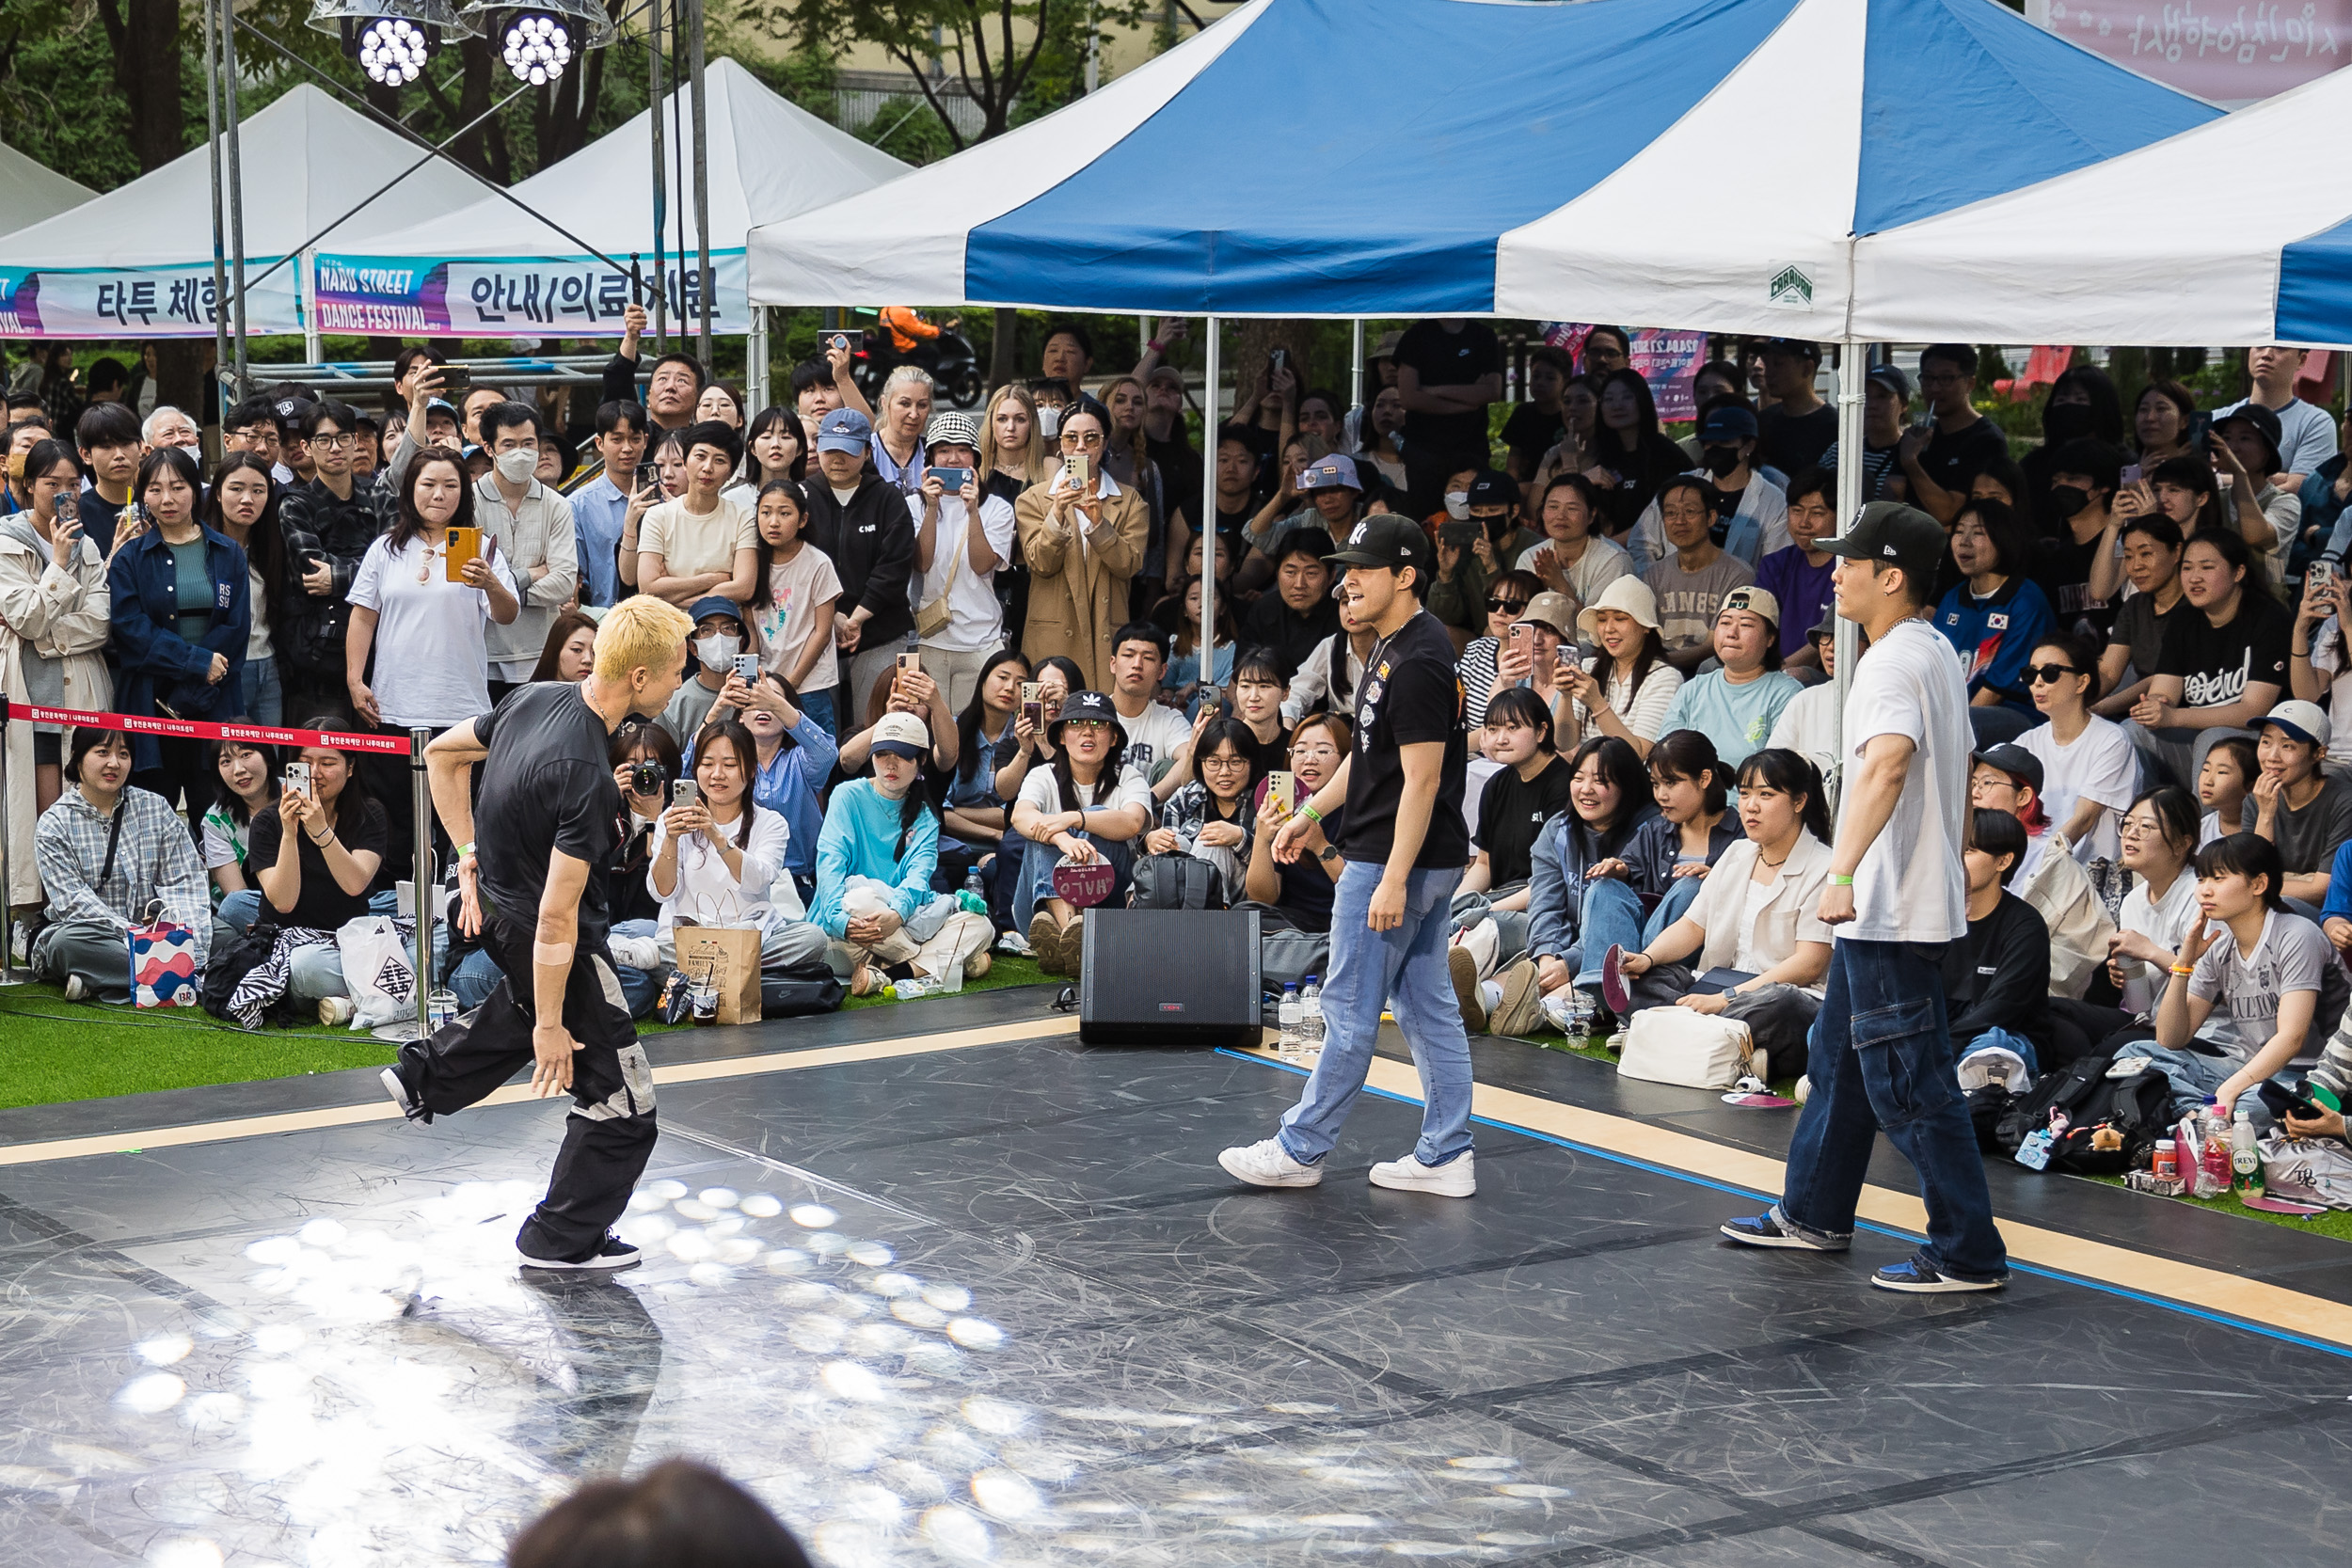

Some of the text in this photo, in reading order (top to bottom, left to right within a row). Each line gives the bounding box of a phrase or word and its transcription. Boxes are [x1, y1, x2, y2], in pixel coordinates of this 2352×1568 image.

[321, 266, 414, 295] NARU STREET
[470, 272, 629, 324] 안내/의료
[1770, 269, 1813, 301] CARAVAN
[97, 280, 158, 325] 타투
[322, 303, 366, 329] DANCE
[368, 306, 428, 332] FESTIVAL
[2185, 645, 2251, 705] Weird
